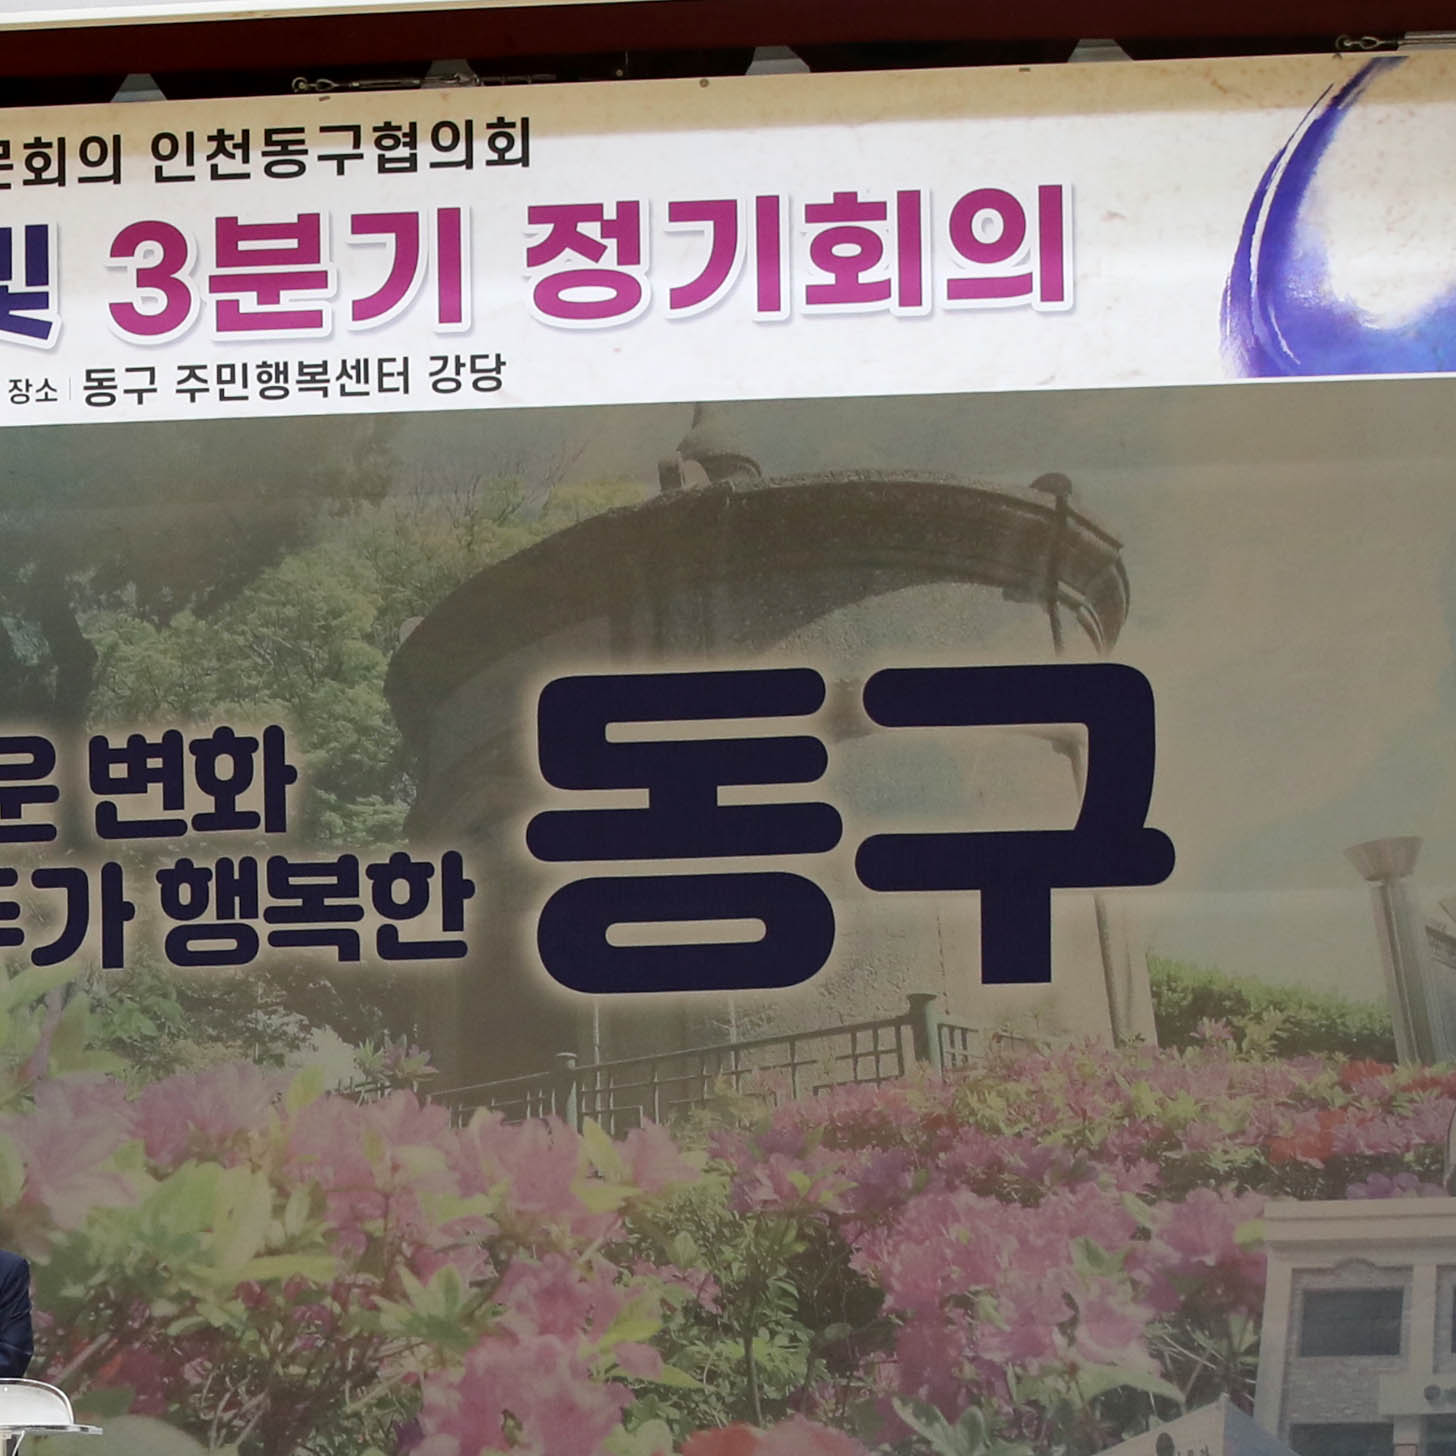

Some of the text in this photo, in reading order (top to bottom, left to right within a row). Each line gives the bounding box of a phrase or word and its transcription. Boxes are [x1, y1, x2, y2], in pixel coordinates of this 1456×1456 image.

[150, 115, 530, 183] 인천동구협의회
[107, 206, 463, 337] 3분기
[525, 184, 1065, 320] 정기회의
[7, 352, 507, 408] 장소 동구 주민행복센터 강당
[88, 724, 299, 840] 변화
[525, 662, 1177, 995] 동구
[156, 849, 477, 968] 행복한
